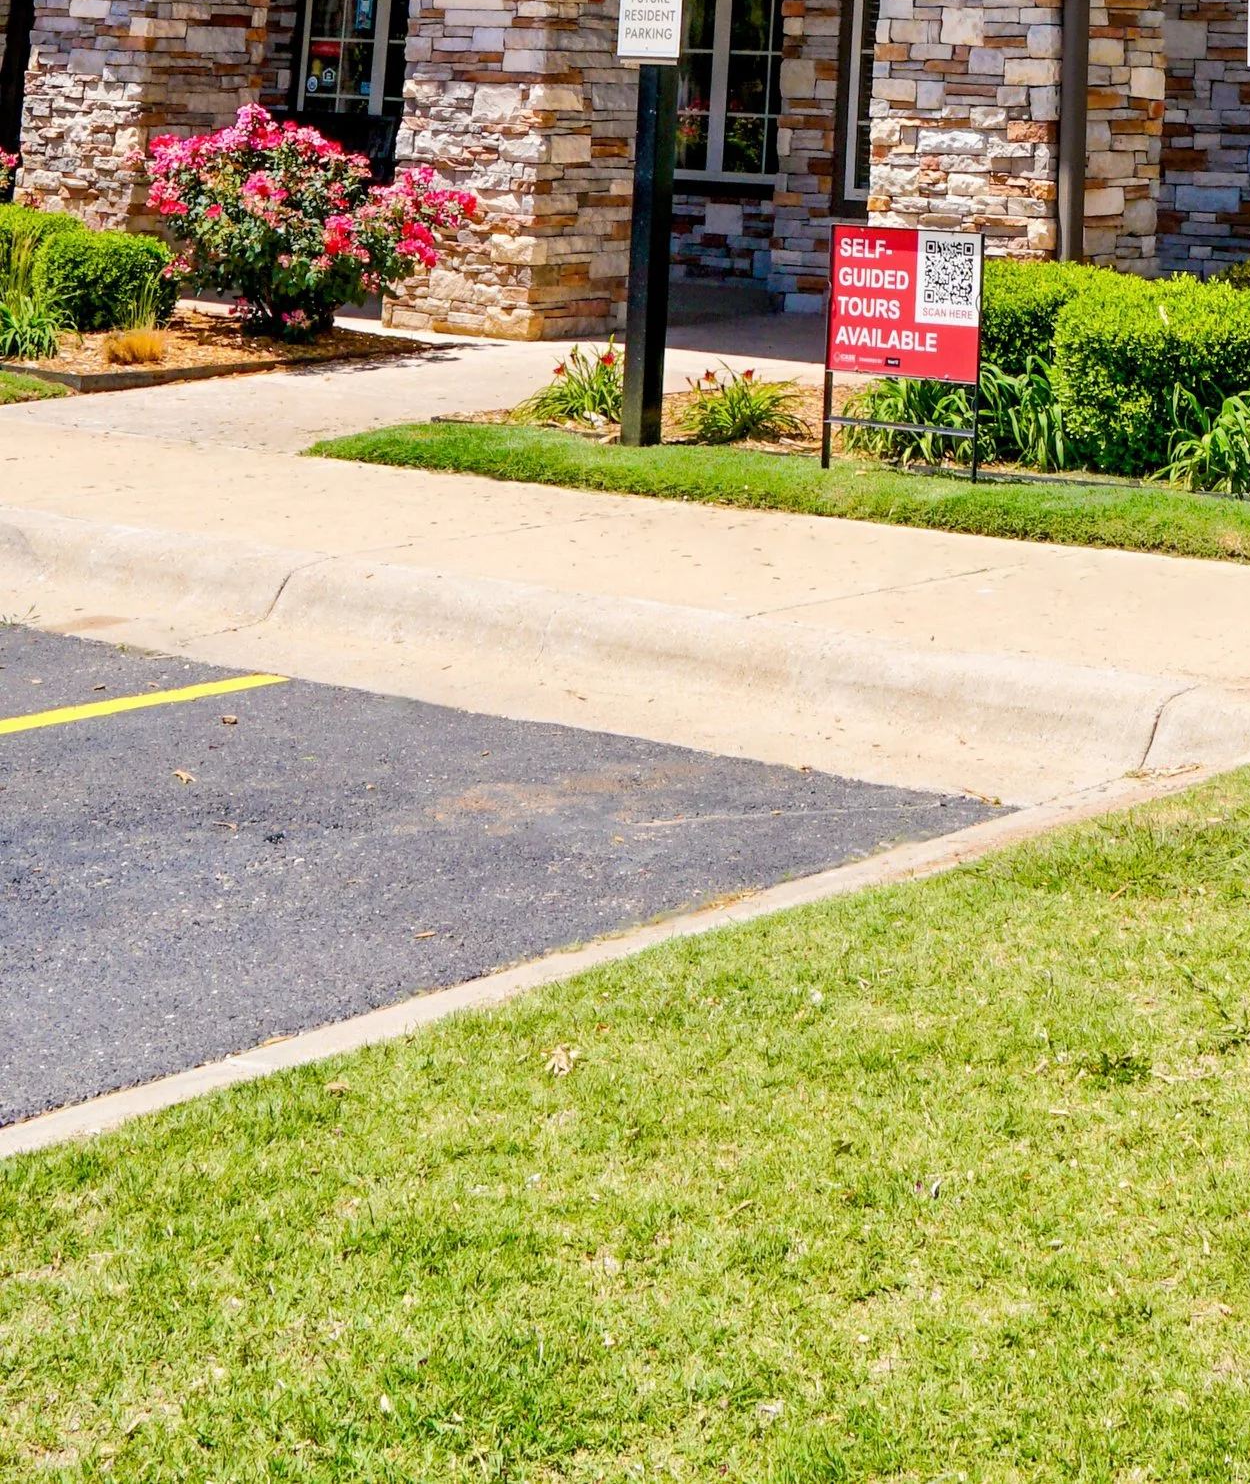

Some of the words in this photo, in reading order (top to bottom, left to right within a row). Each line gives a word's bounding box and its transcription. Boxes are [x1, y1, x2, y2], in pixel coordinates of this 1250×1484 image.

[624, 9, 676, 22] RESIDENT
[625, 27, 673, 40] PARKING
[839, 237, 893, 259] SELF-
[838, 266, 909, 290] GUIDED
[837, 296, 901, 320] TOURS
[922, 307, 947, 318] SCAN
[948, 309, 974, 320] HERE
[835, 325, 938, 353] AVAILABLE
